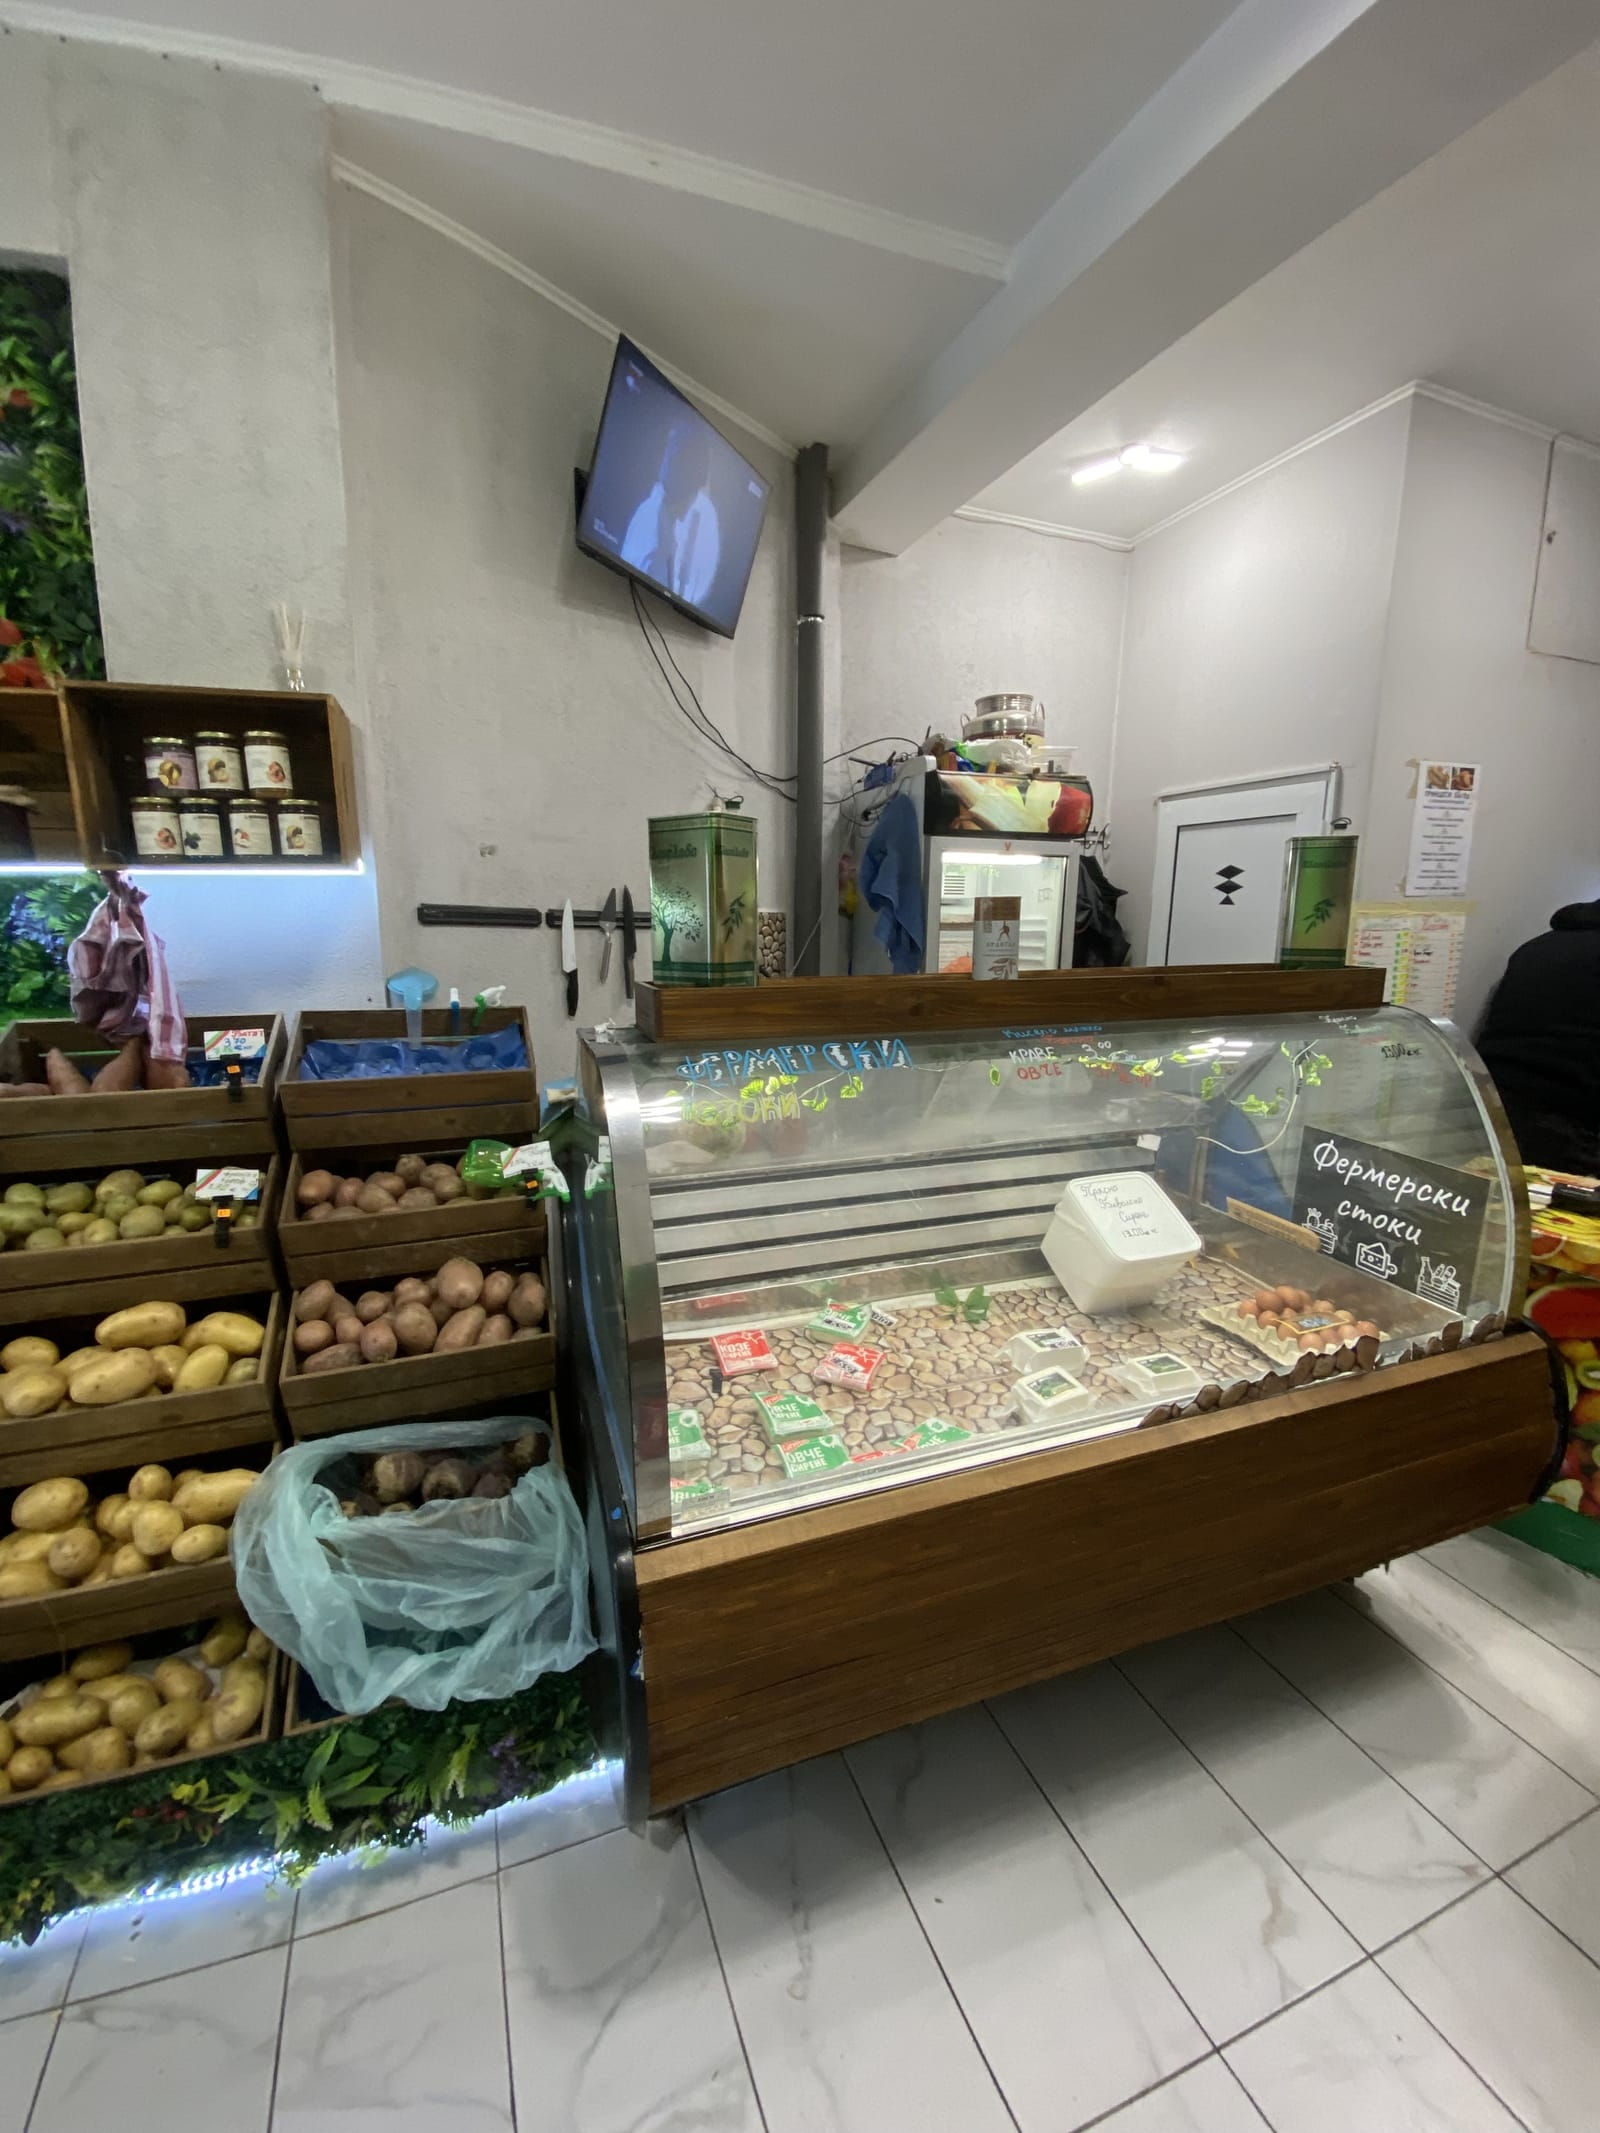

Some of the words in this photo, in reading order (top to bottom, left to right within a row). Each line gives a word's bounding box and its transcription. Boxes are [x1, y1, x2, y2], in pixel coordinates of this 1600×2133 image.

[676, 1038, 913, 1088] ФЕРМЕРСКИ
[1009, 1046, 1057, 1064] КРАВЕ
[1313, 1139, 1471, 1217] Фермерски
[1337, 1200, 1424, 1245] стоки
[719, 1342, 752, 1353] КОЗЕ
[786, 1446, 825, 1464] ОВЧЕ
[790, 1458, 828, 1473] СИРЕНЕ
